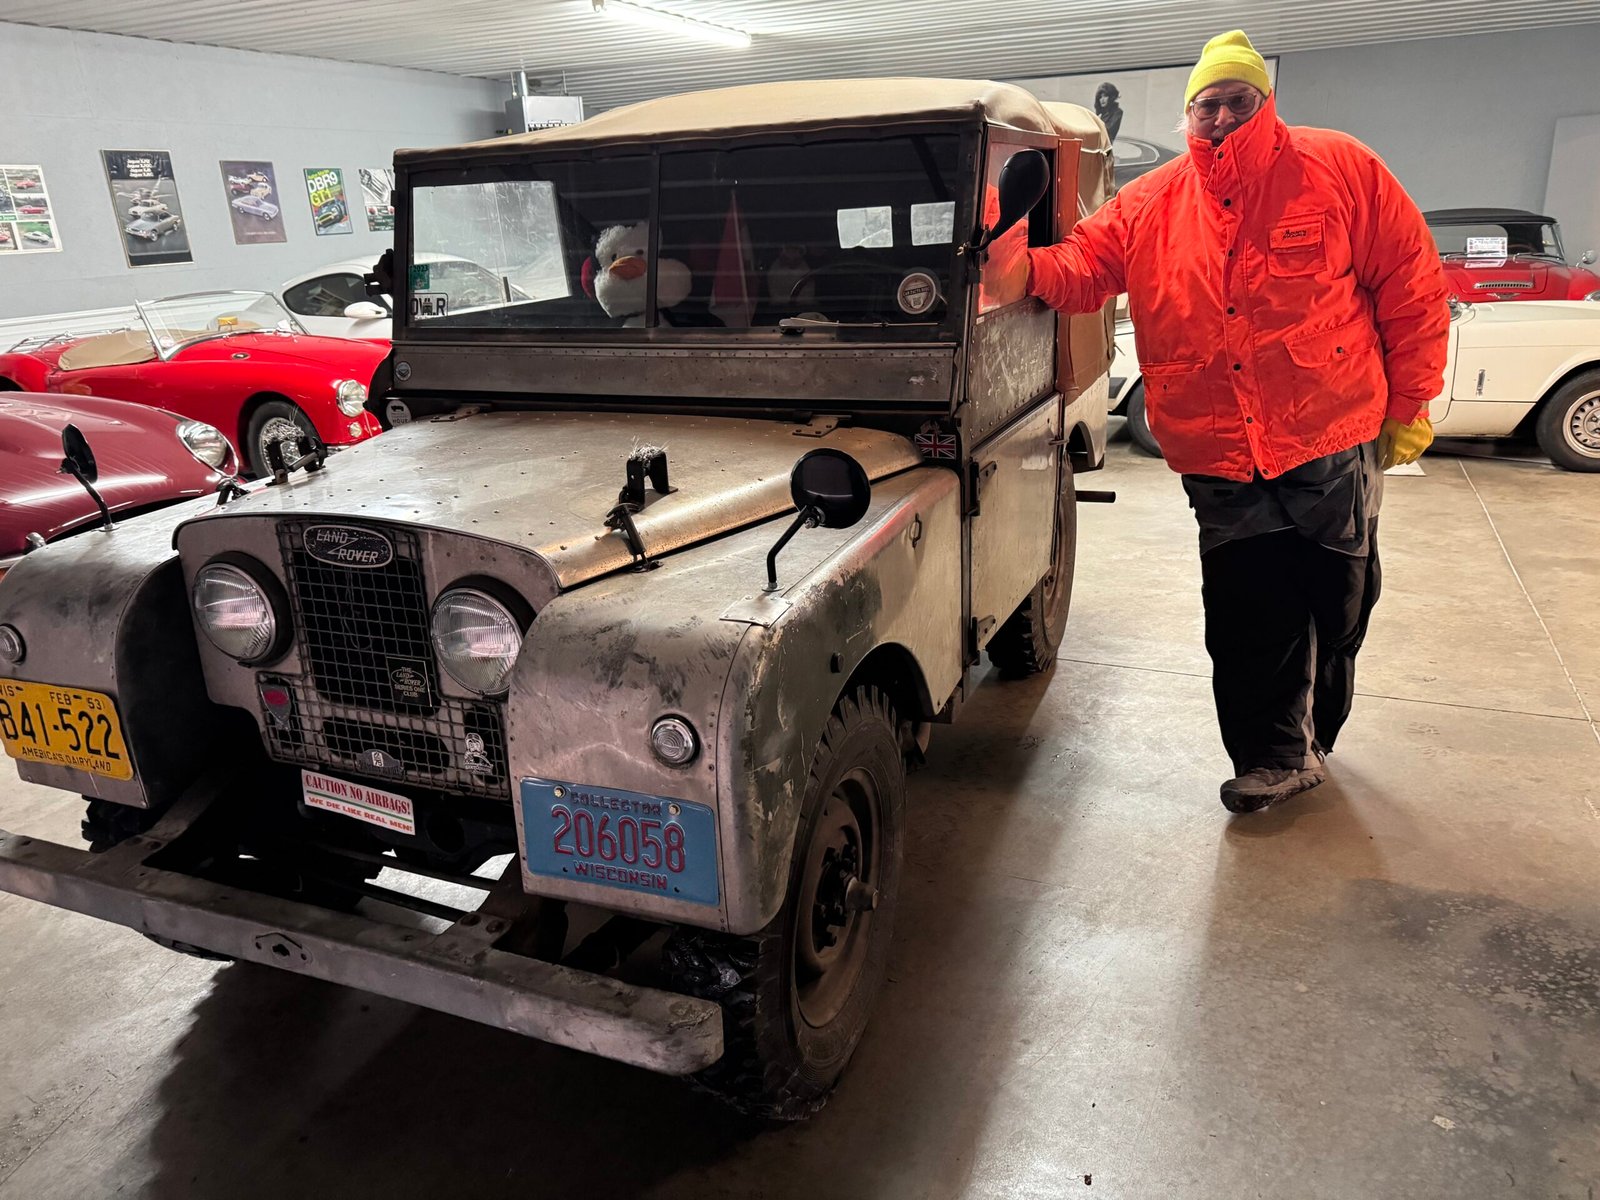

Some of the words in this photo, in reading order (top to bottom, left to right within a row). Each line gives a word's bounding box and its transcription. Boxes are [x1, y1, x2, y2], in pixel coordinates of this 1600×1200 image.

[307, 171, 338, 193] DBR9
[310, 188, 332, 206] GT1
[316, 530, 348, 544] LAND
[337, 548, 379, 564] ROVER
[49, 691, 72, 706] FEB
[22, 746, 66, 763] AMERICA'S
[65, 755, 112, 772] DAIRYLAND
[305, 774, 348, 797] CAUTION
[349, 786, 363, 801] NO
[365, 790, 411, 815] AIRBAGS!
[570, 792, 663, 816] COLLECTOR
[308, 796, 324, 806] WE
[326, 801, 341, 810] DIE
[342, 805, 362, 817] LIKE
[364, 812, 388, 825] REAL
[389, 819, 413, 832] MEN!
[551, 804, 686, 873] 206058
[573, 860, 667, 890] WISCONSIN
